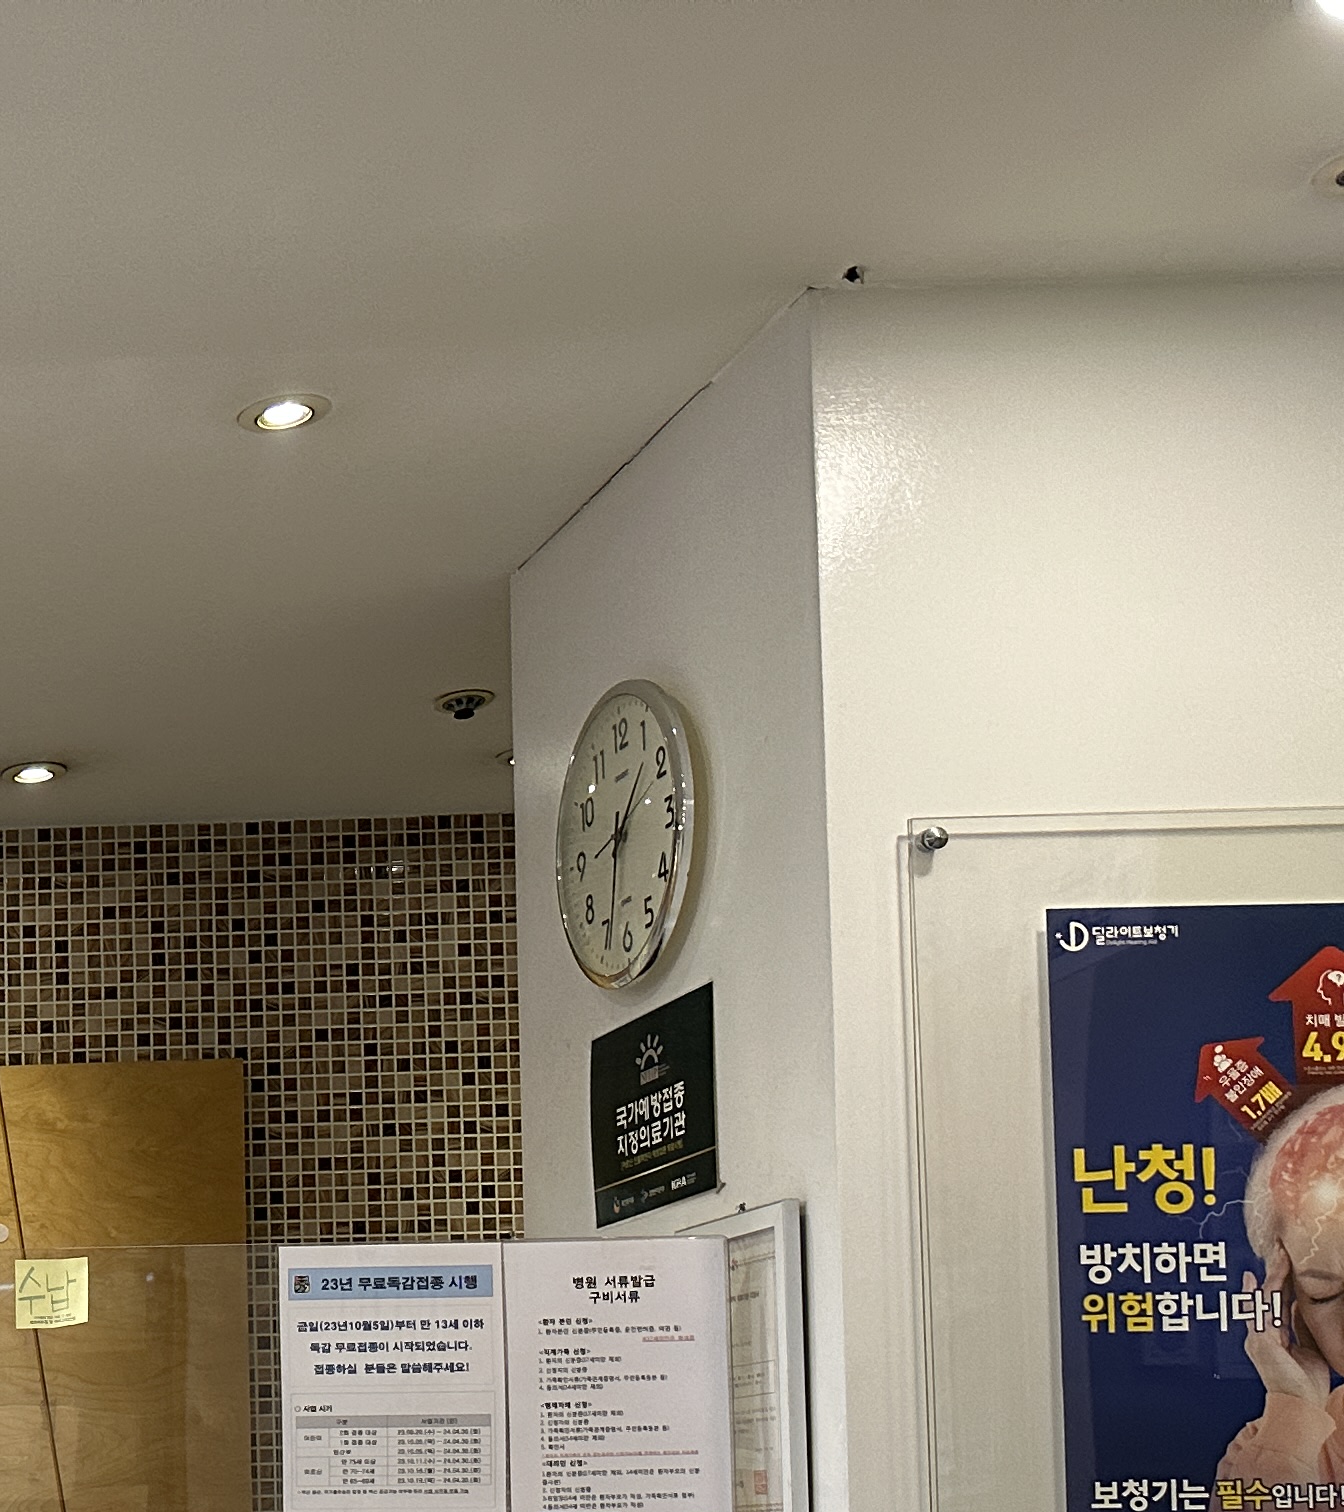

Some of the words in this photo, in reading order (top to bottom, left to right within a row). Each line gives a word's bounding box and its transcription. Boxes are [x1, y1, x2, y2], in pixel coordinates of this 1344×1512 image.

[613, 718, 629, 753] 12
[640, 720, 646, 750] 1
[593, 750, 605, 784] 11
[655, 746, 666, 779] 2
[580, 797, 594, 832] 10
[665, 795, 674, 829] 3
[577, 851, 586, 882] 9
[658, 852, 669, 882] 4
[586, 894, 594, 925] 8
[644, 896, 654, 928] 5
[602, 919, 611, 950] 7
[623, 922, 633, 952] 6
[1092, 925, 1179, 945] 딜라이트보청기
[1305, 1014, 1330, 1027] 치매
[616, 1081, 685, 1130] 국가예방접종
[1241, 1081, 1283, 1120] 1.7배
[617, 1111, 686, 1156] 지정의료기관
[1073, 1145, 1217, 1214] 난청!
[1079, 1241, 1228, 1284] 방치하면
[18, 1266, 76, 1315] 수납
[322, 1278, 352, 1291] 23년
[358, 1276, 444, 1291] 무료독감접종
[449, 1275, 478, 1289] 시행
[573, 1277, 597, 1289] 병원
[605, 1275, 655, 1288] 서류발급
[589, 1291, 640, 1304] 구비서류
[420, 1319, 430, 1330] 만
[435, 1319, 459, 1330] 13세
[463, 1318, 484, 1329] 이하
[1081, 1290, 1282, 1332] 위험합니다!
[310, 1341, 331, 1353] 독감
[335, 1341, 389, 1353] 무료접종이
[314, 1363, 357, 1374] 접종하실
[364, 1363, 396, 1373] 분들은
[1091, 1479, 1210, 1511] 보청기는
[1216, 1479, 1344, 1511] 필수입니다!
